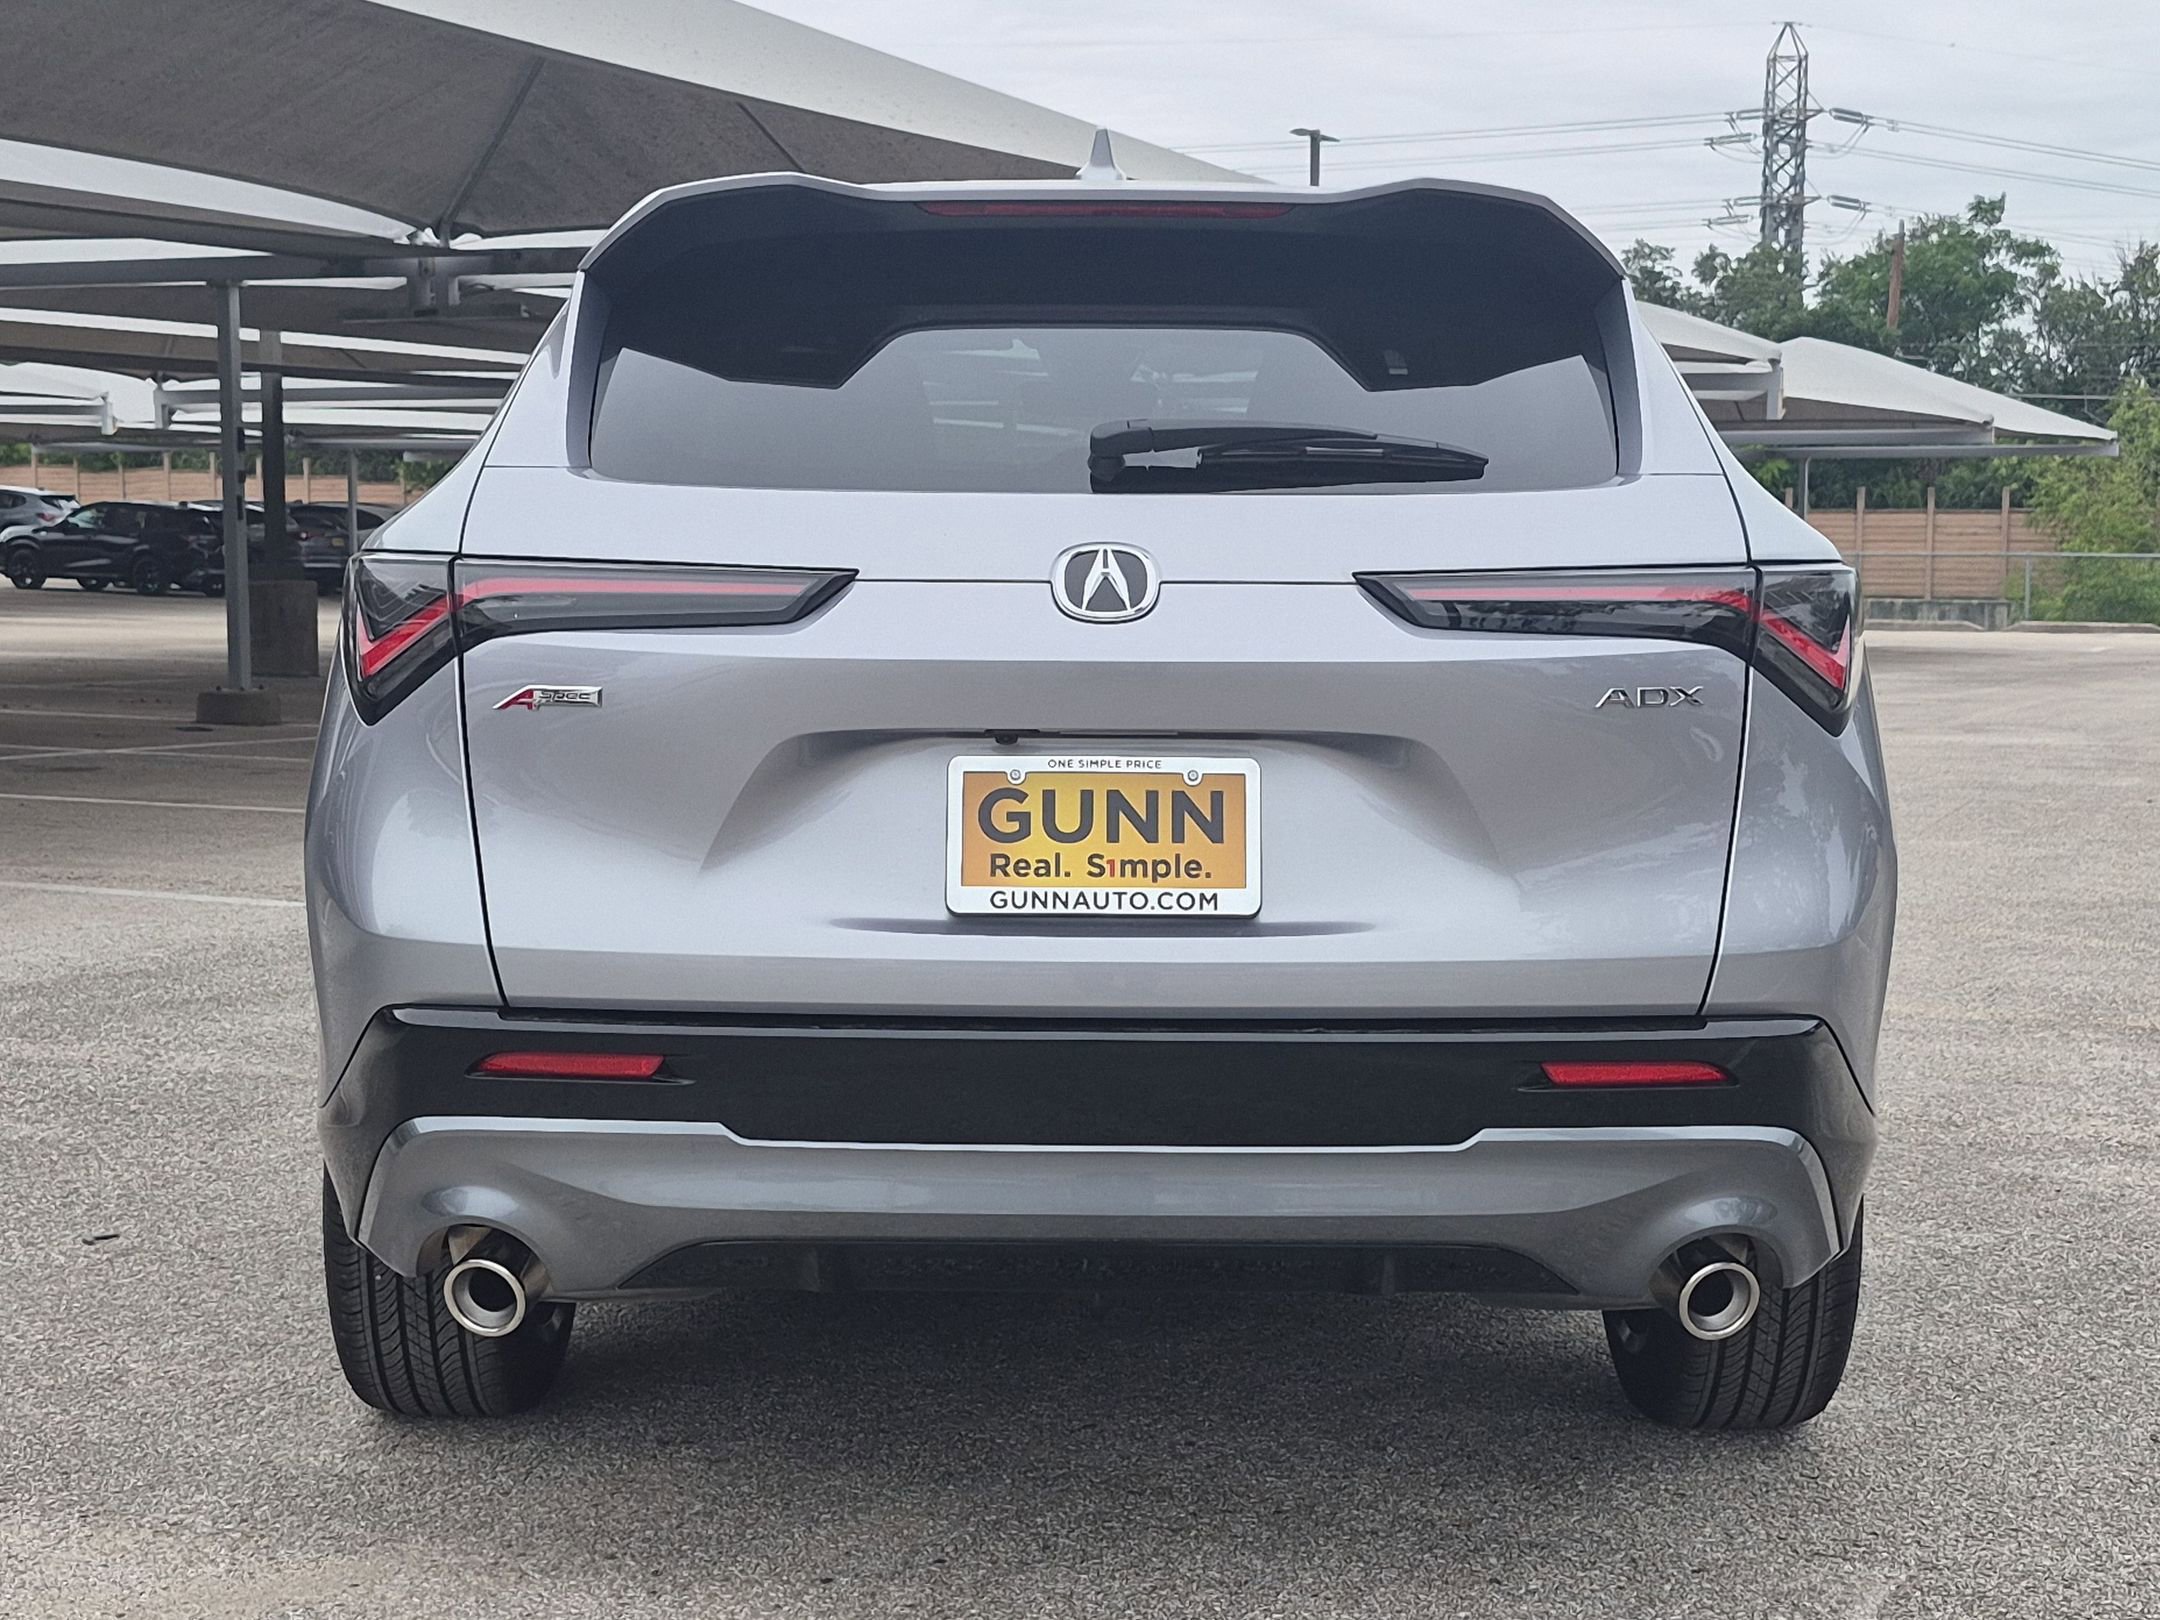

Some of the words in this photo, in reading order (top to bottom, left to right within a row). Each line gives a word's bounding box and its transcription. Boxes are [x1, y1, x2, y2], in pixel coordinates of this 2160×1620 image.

[1595, 686, 1704, 708] ADX
[1047, 758, 1074, 768] ONE
[1078, 759, 1122, 769] SIMPLE
[1126, 759, 1162, 769] PRICE
[977, 787, 1224, 844] GUNN
[989, 852, 1071, 878] Real.
[989, 890, 1218, 911] GUNNAUTO.COM
